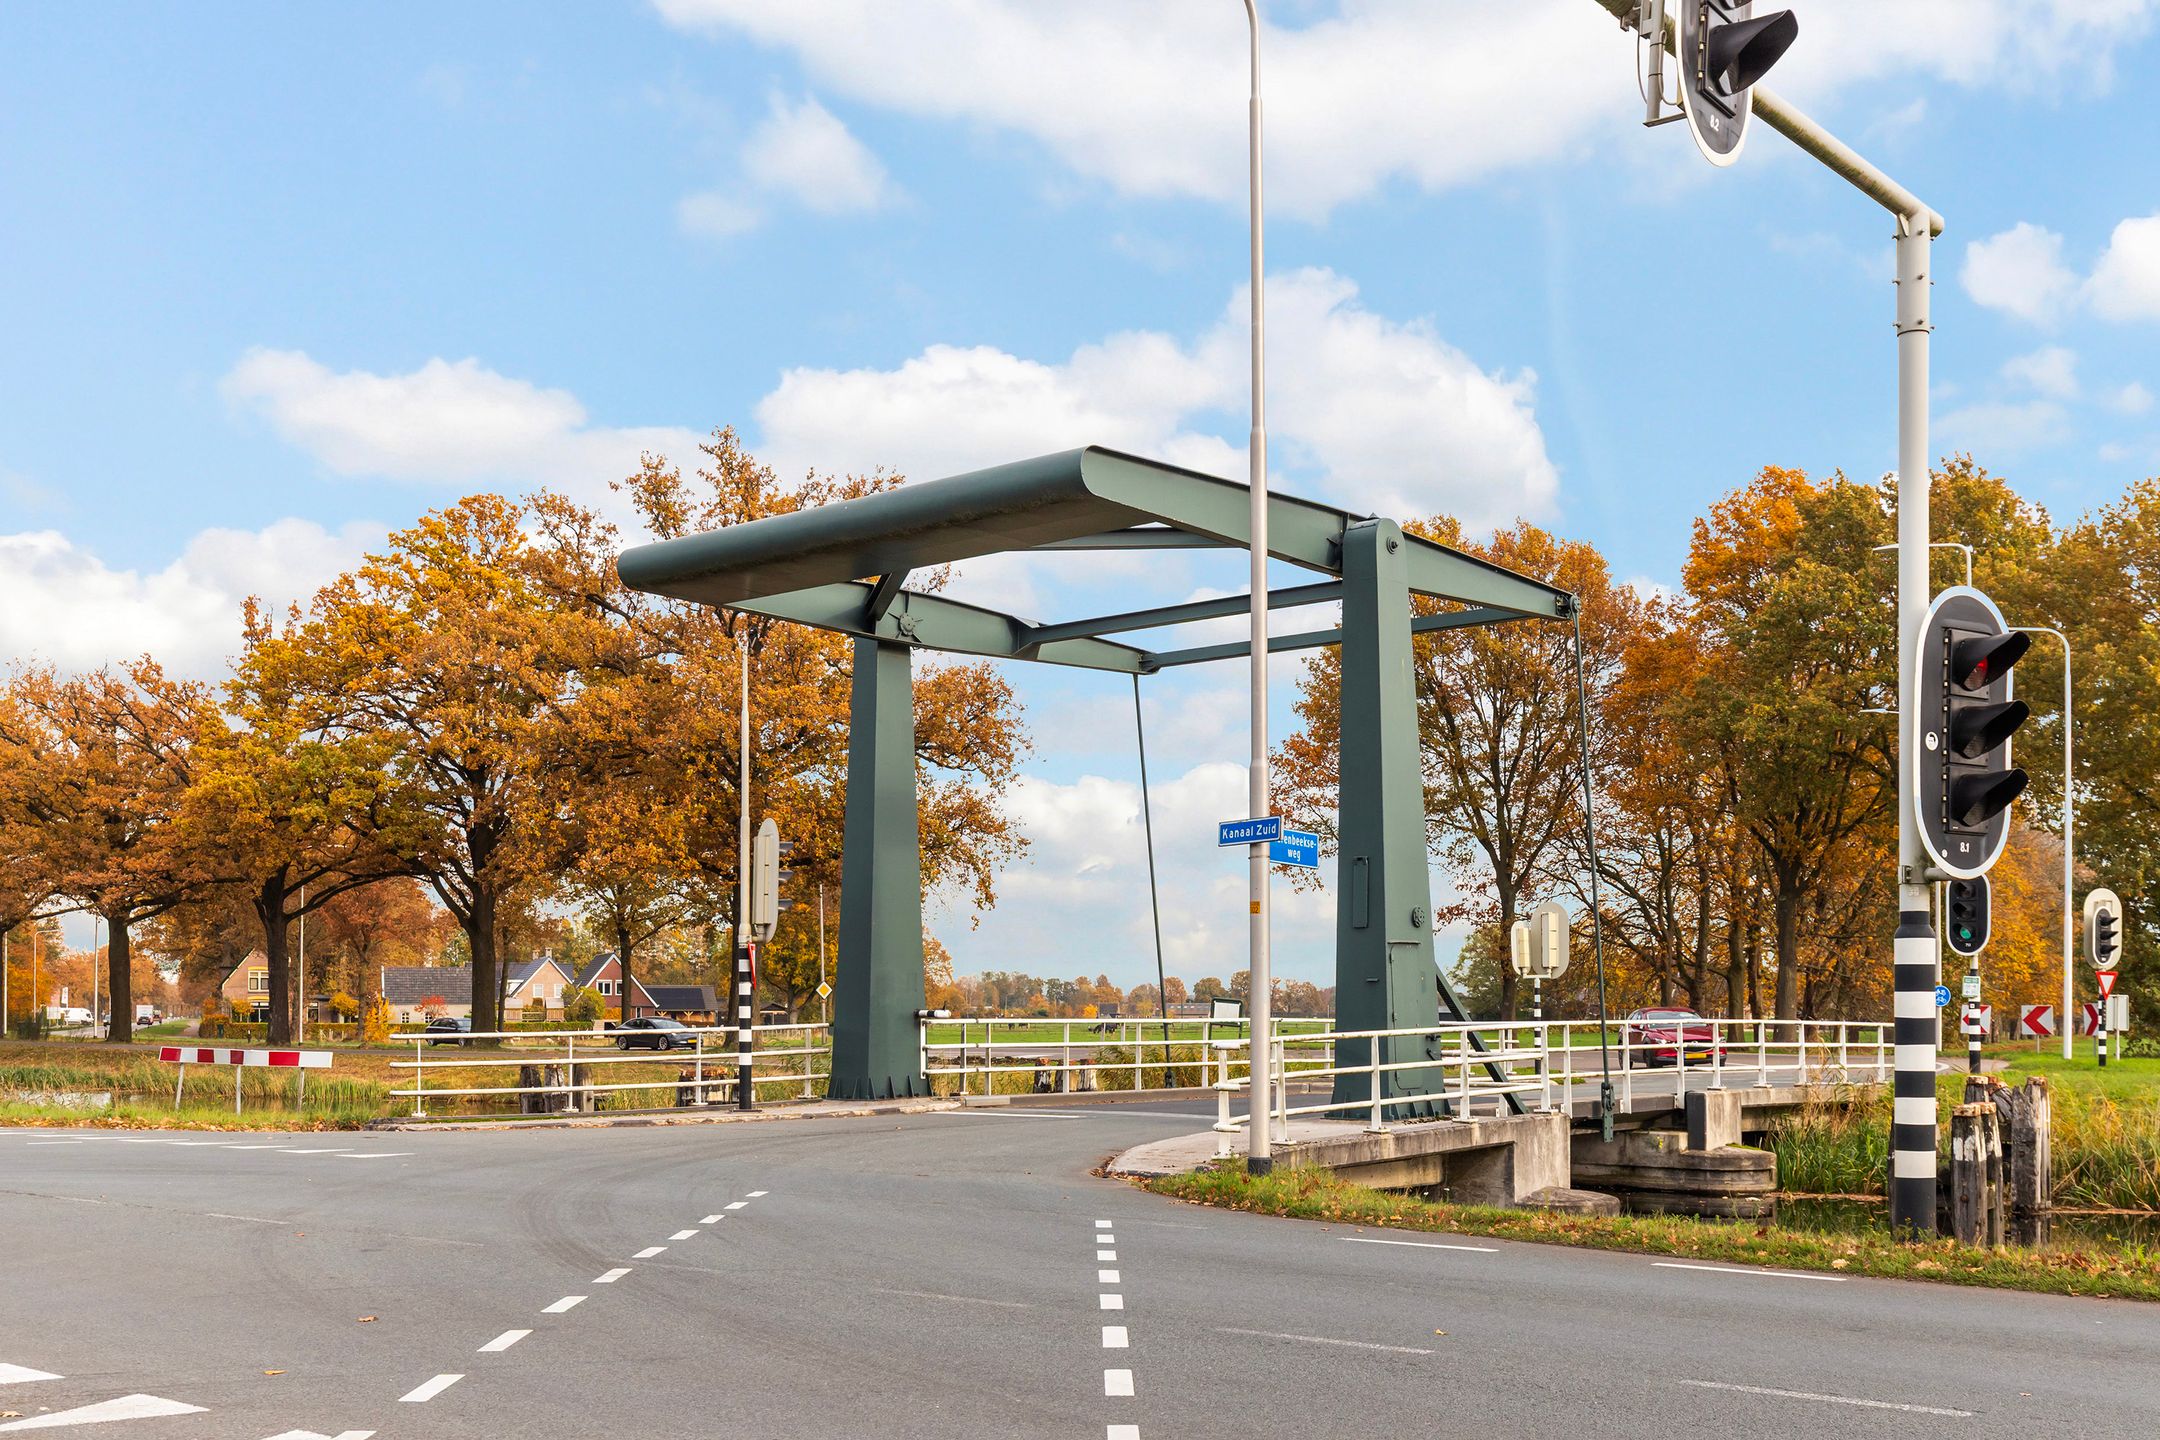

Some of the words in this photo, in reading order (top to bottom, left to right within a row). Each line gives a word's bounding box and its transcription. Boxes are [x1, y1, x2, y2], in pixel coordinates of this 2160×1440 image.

[1222, 825, 1254, 840] Kanaal
[1256, 823, 1277, 836] Zuid
[1960, 841, 1970, 853] 8.1
[1287, 848, 1301, 862] weg
